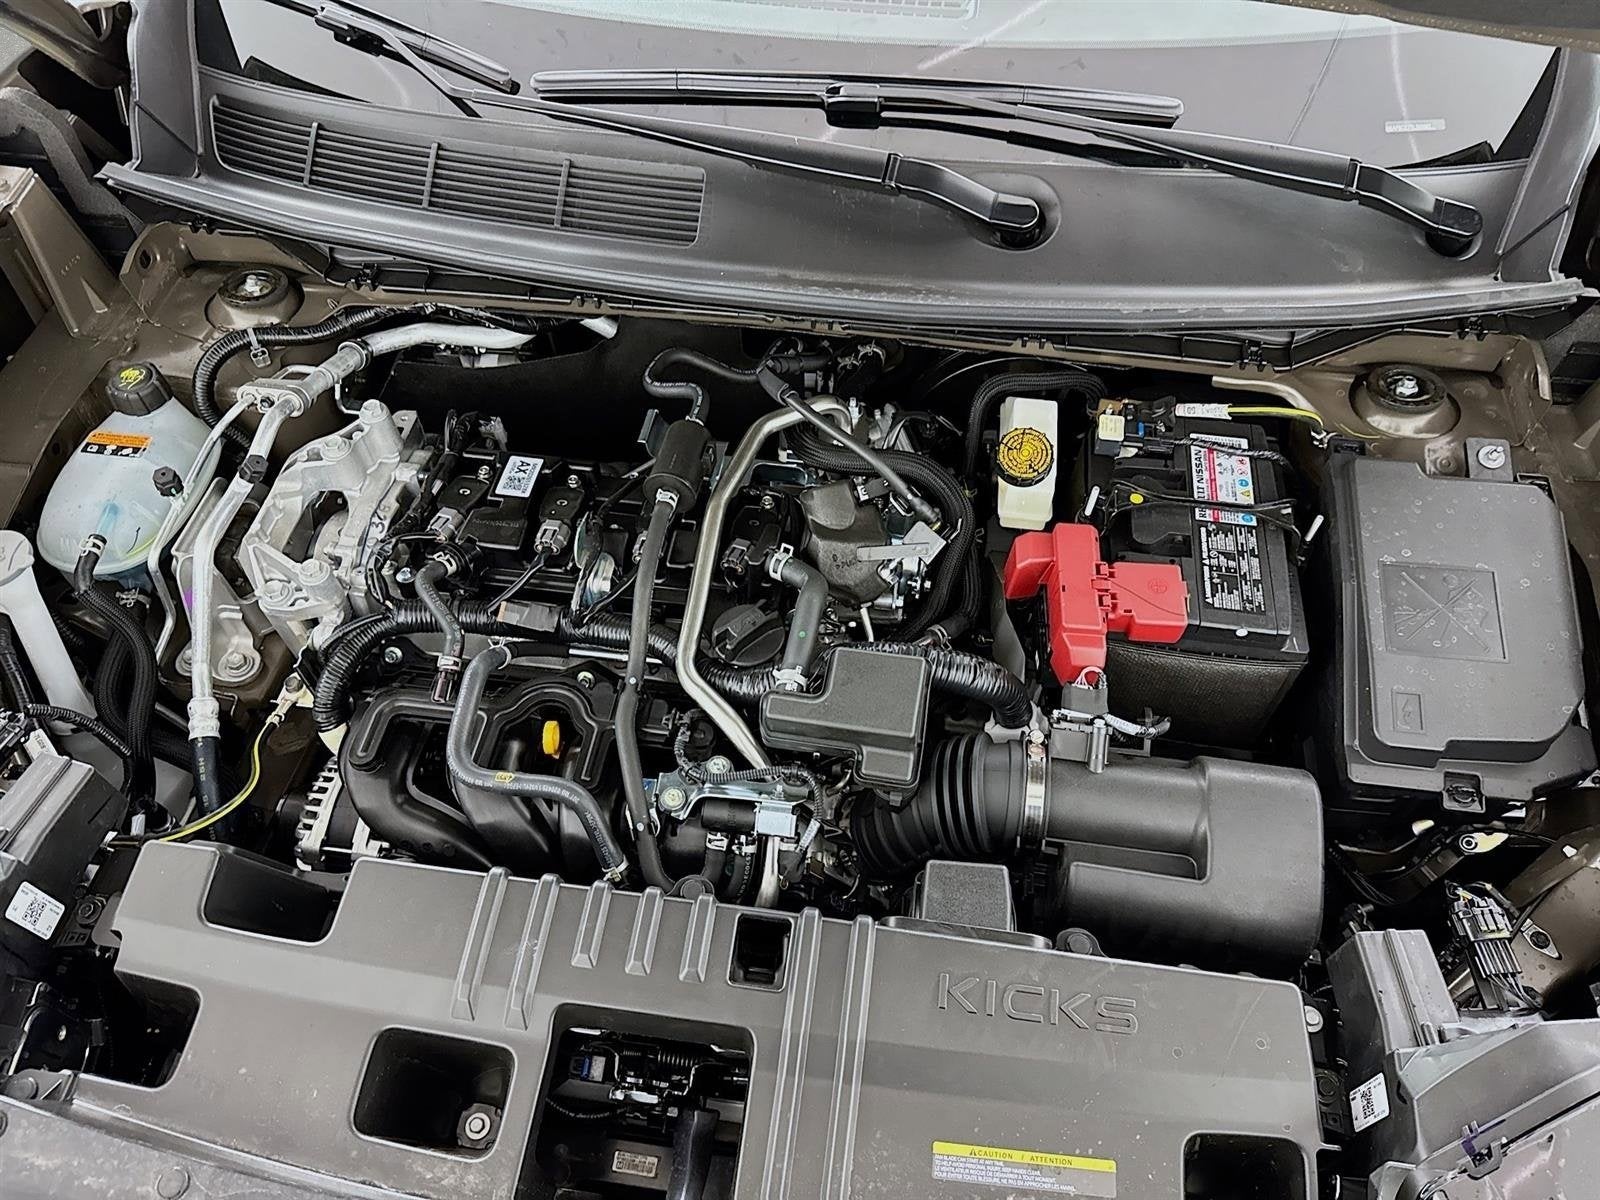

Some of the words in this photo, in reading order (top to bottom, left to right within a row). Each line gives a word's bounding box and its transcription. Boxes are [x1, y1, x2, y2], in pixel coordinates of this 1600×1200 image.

[515, 460, 531, 474] AX
[1194, 449, 1204, 484] NISSAN
[937, 972, 1139, 1035] KICKS
[977, 1150, 1014, 1160] CAUTION
[1030, 1155, 1073, 1167] ATTENTION
